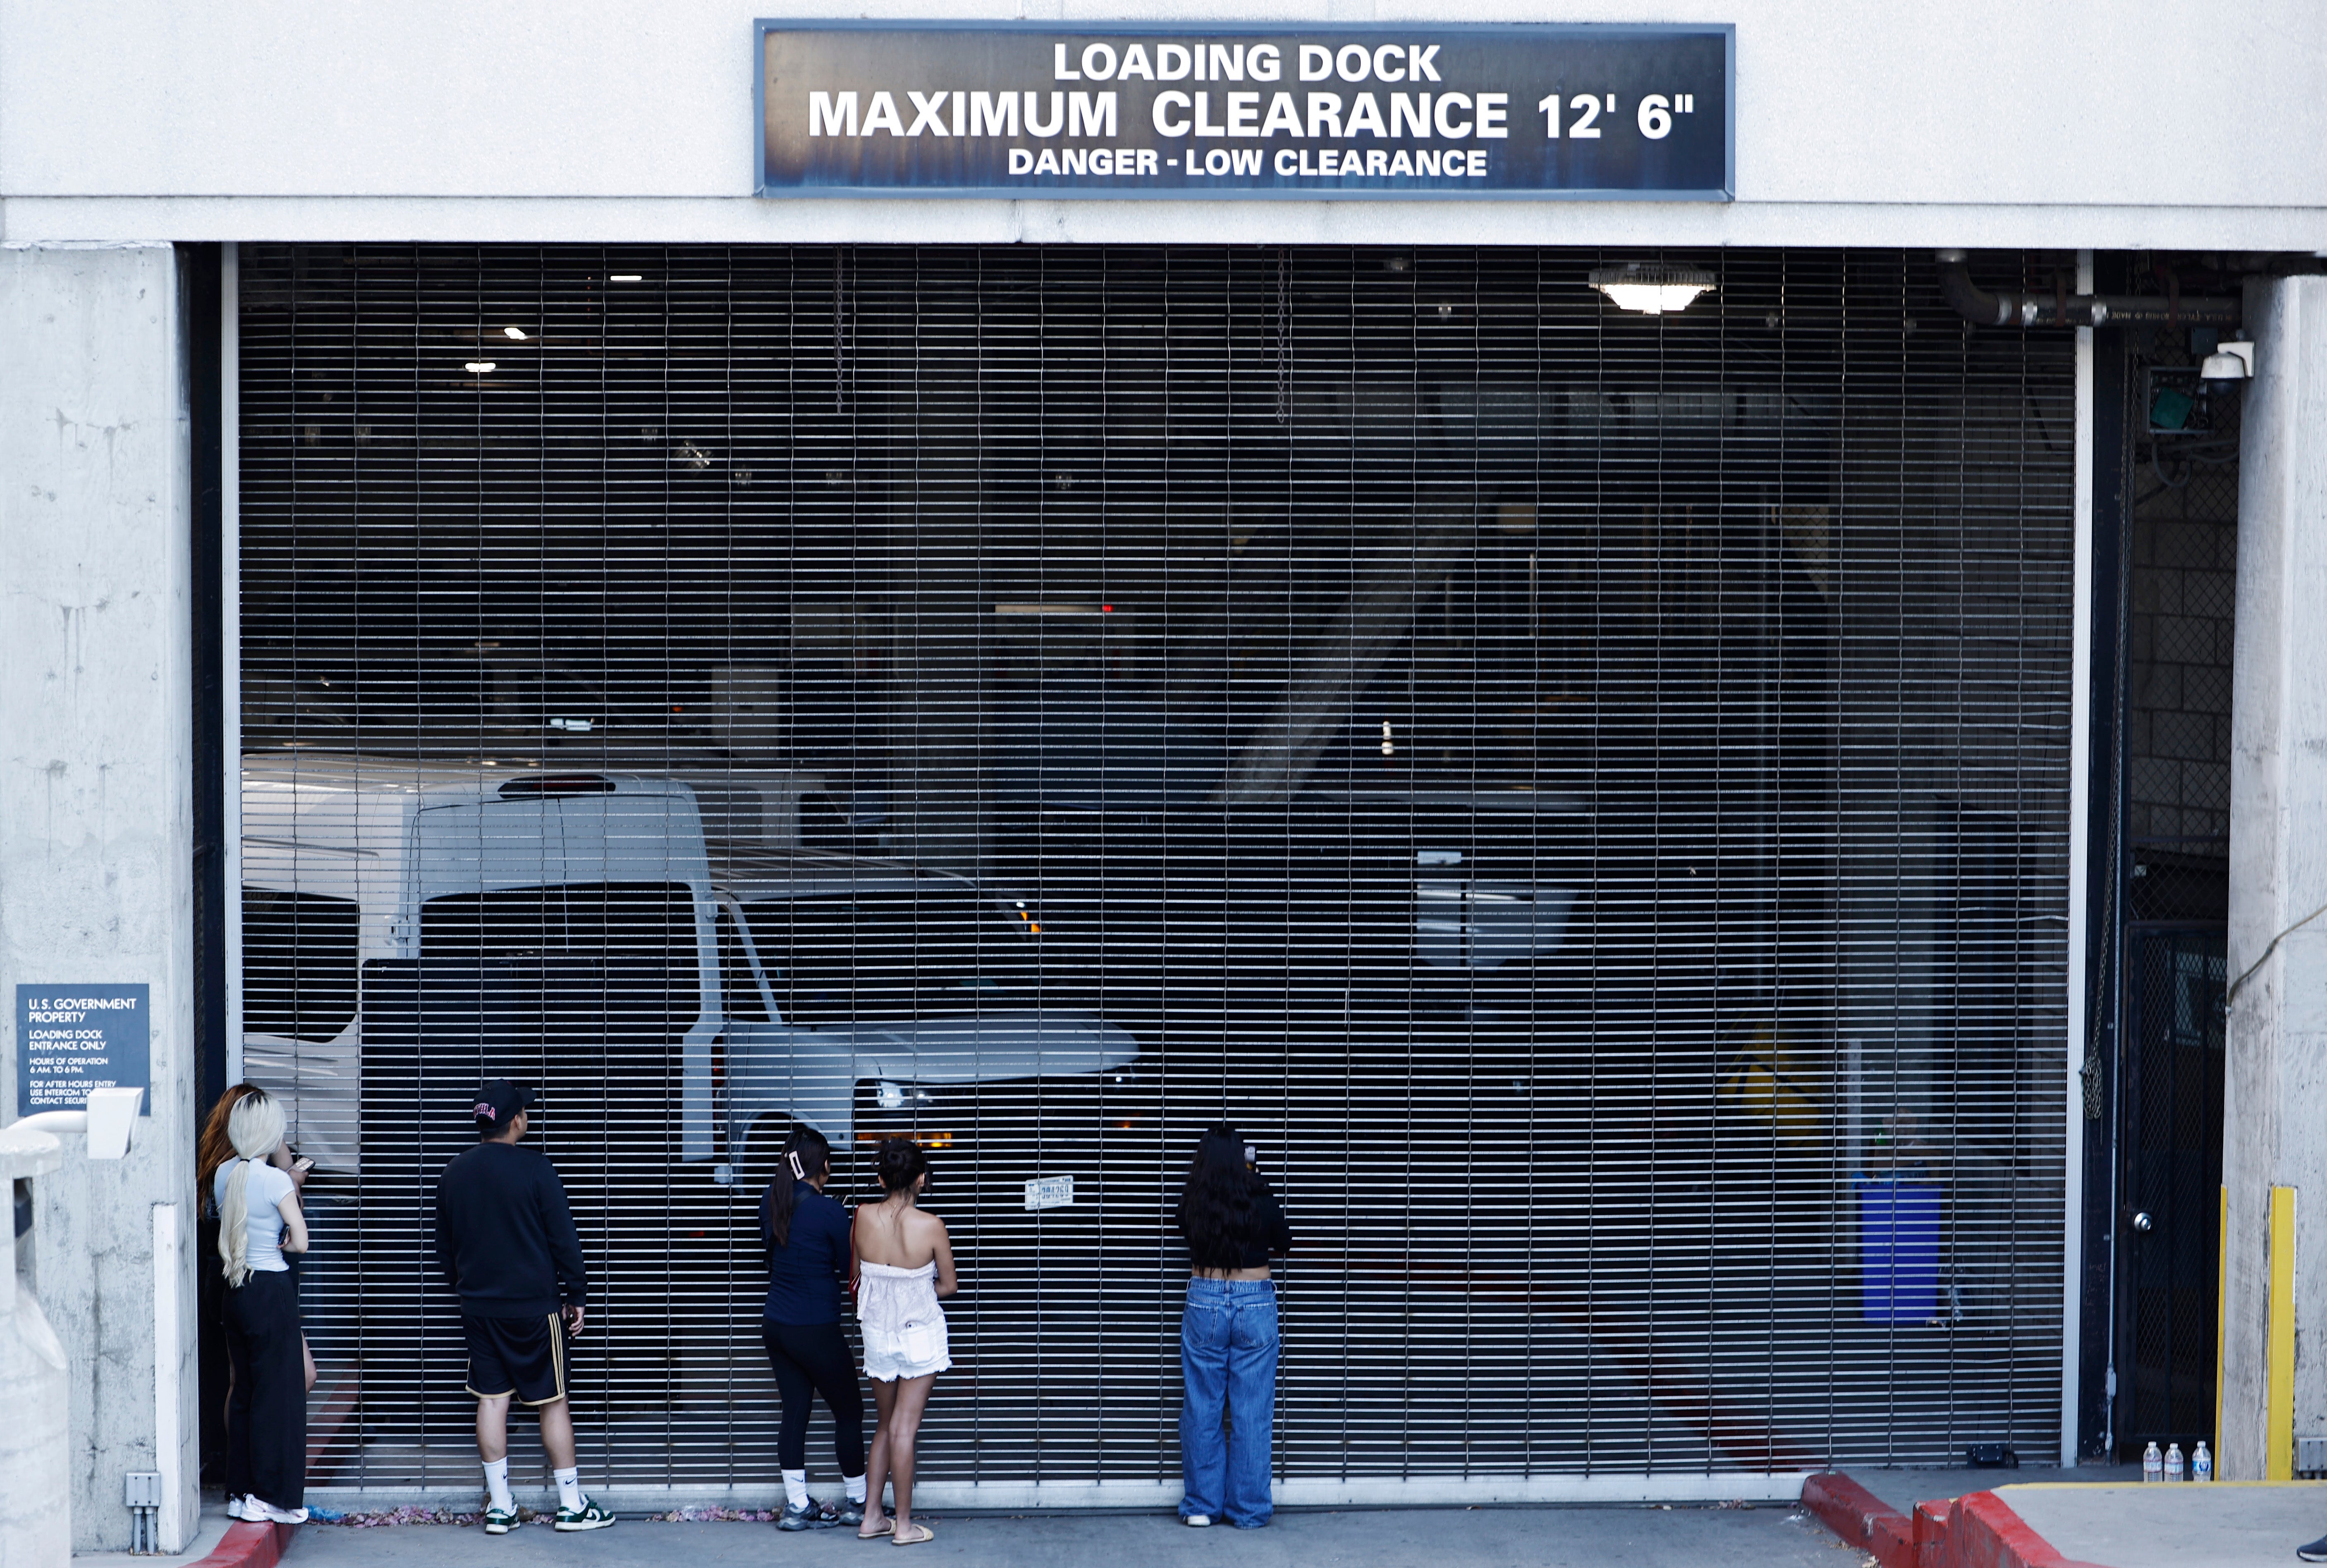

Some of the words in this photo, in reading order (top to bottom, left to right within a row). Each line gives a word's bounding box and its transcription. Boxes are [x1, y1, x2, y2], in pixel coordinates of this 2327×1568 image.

[1054, 43, 1281, 82] LOADING
[1299, 44, 1442, 83] DOCK
[807, 91, 1117, 137] MAXIMUM
[1152, 91, 1508, 139] CLEARANCE
[1538, 93, 1615, 139] 12'
[1637, 93, 1693, 139] 6"
[1008, 148, 1159, 176] DANGER
[1186, 148, 1263, 177] LOW
[1274, 149, 1487, 177] CLEARANCE
[29, 998, 51, 1010] U.S.
[53, 998, 137, 1010] GOVERNMENT
[29, 1011, 86, 1023] PROPERTY
[29, 1030, 74, 1040] LOADING
[75, 1030, 103, 1040] DOCK
[29, 1041, 78, 1051] ENTRANCE
[80, 1040, 107, 1051] ONLY
[30, 1066, 35, 1074] 6
[65, 1066, 70, 1074] 6
[30, 1080, 43, 1088] FOR
[45, 1080, 67, 1088] AFTER
[68, 1080, 93, 1088] HOURS
[30, 1088, 43, 1097] USE
[44, 1088, 80, 1097] INTERCOM
[30, 1097, 62, 1105] CONTACT
[64, 1097, 86, 1105] SECURI
